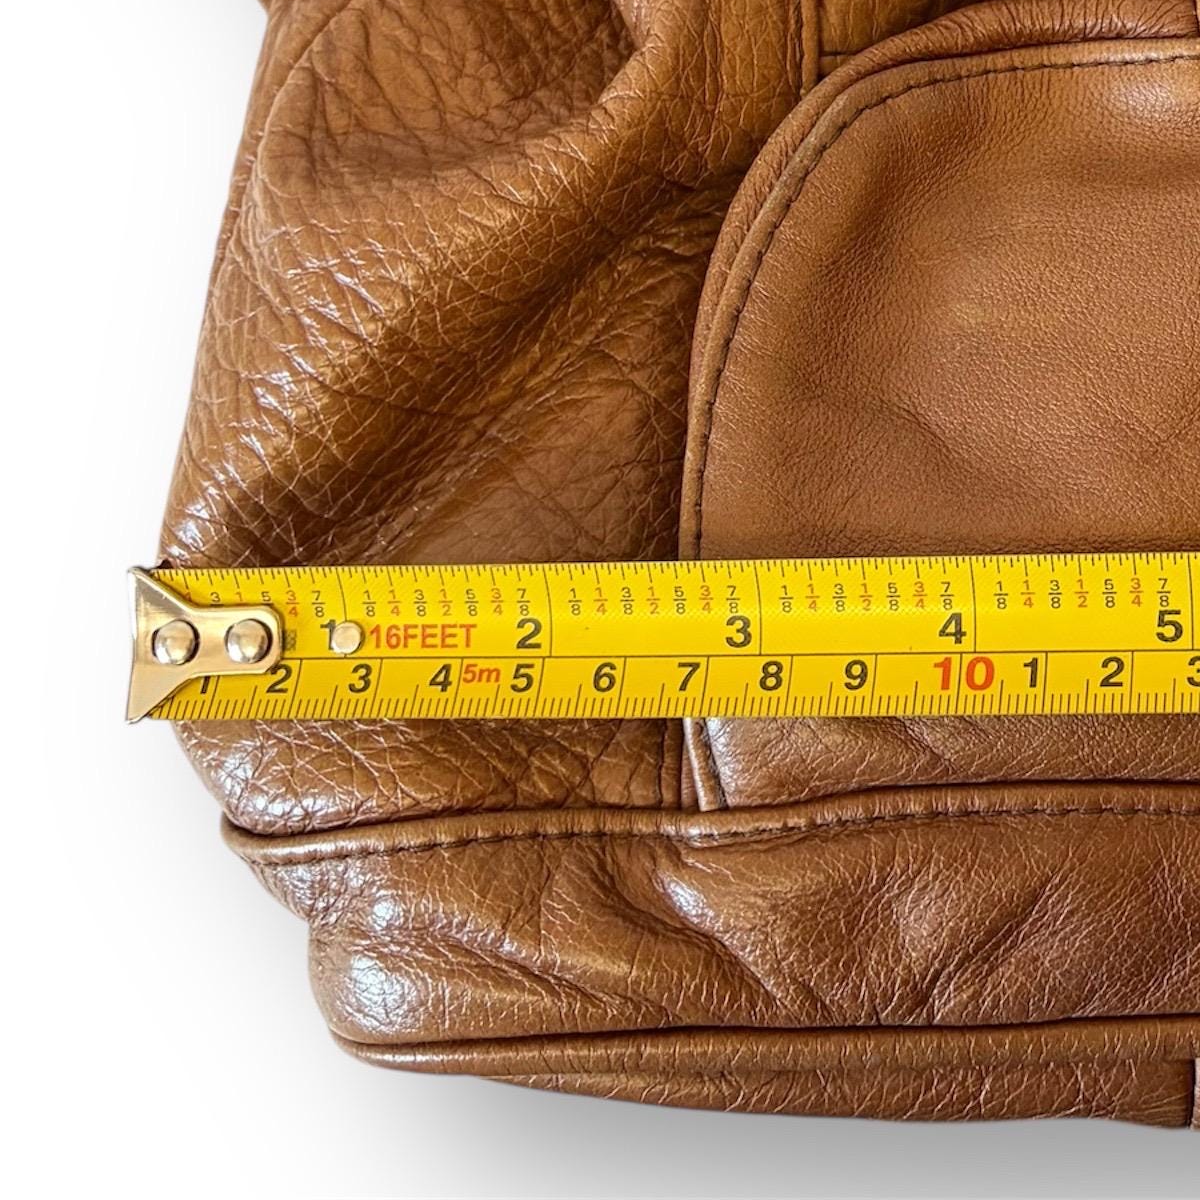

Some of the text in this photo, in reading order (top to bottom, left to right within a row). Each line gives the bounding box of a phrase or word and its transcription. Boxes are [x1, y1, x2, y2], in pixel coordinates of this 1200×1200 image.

[369, 623, 477, 650] 16FEET
[516, 618, 542, 650] 2
[726, 616, 752, 648] 3
[938, 612, 966, 644] 4
[1156, 610, 1183, 642] 5
[266, 663, 292, 694] 2
[348, 664, 372, 692] 3
[429, 664, 452, 692] 4
[510, 664, 535, 692] 5
[592, 662, 617, 692] 6
[677, 662, 700, 692] 7
[759, 660, 783, 691] 8
[844, 660, 868, 690] 9
[933, 656, 994, 691] 10
[1023, 658, 1038, 688] 1
[1099, 656, 1124, 687] 2
[462, 664, 500, 684] 5m
